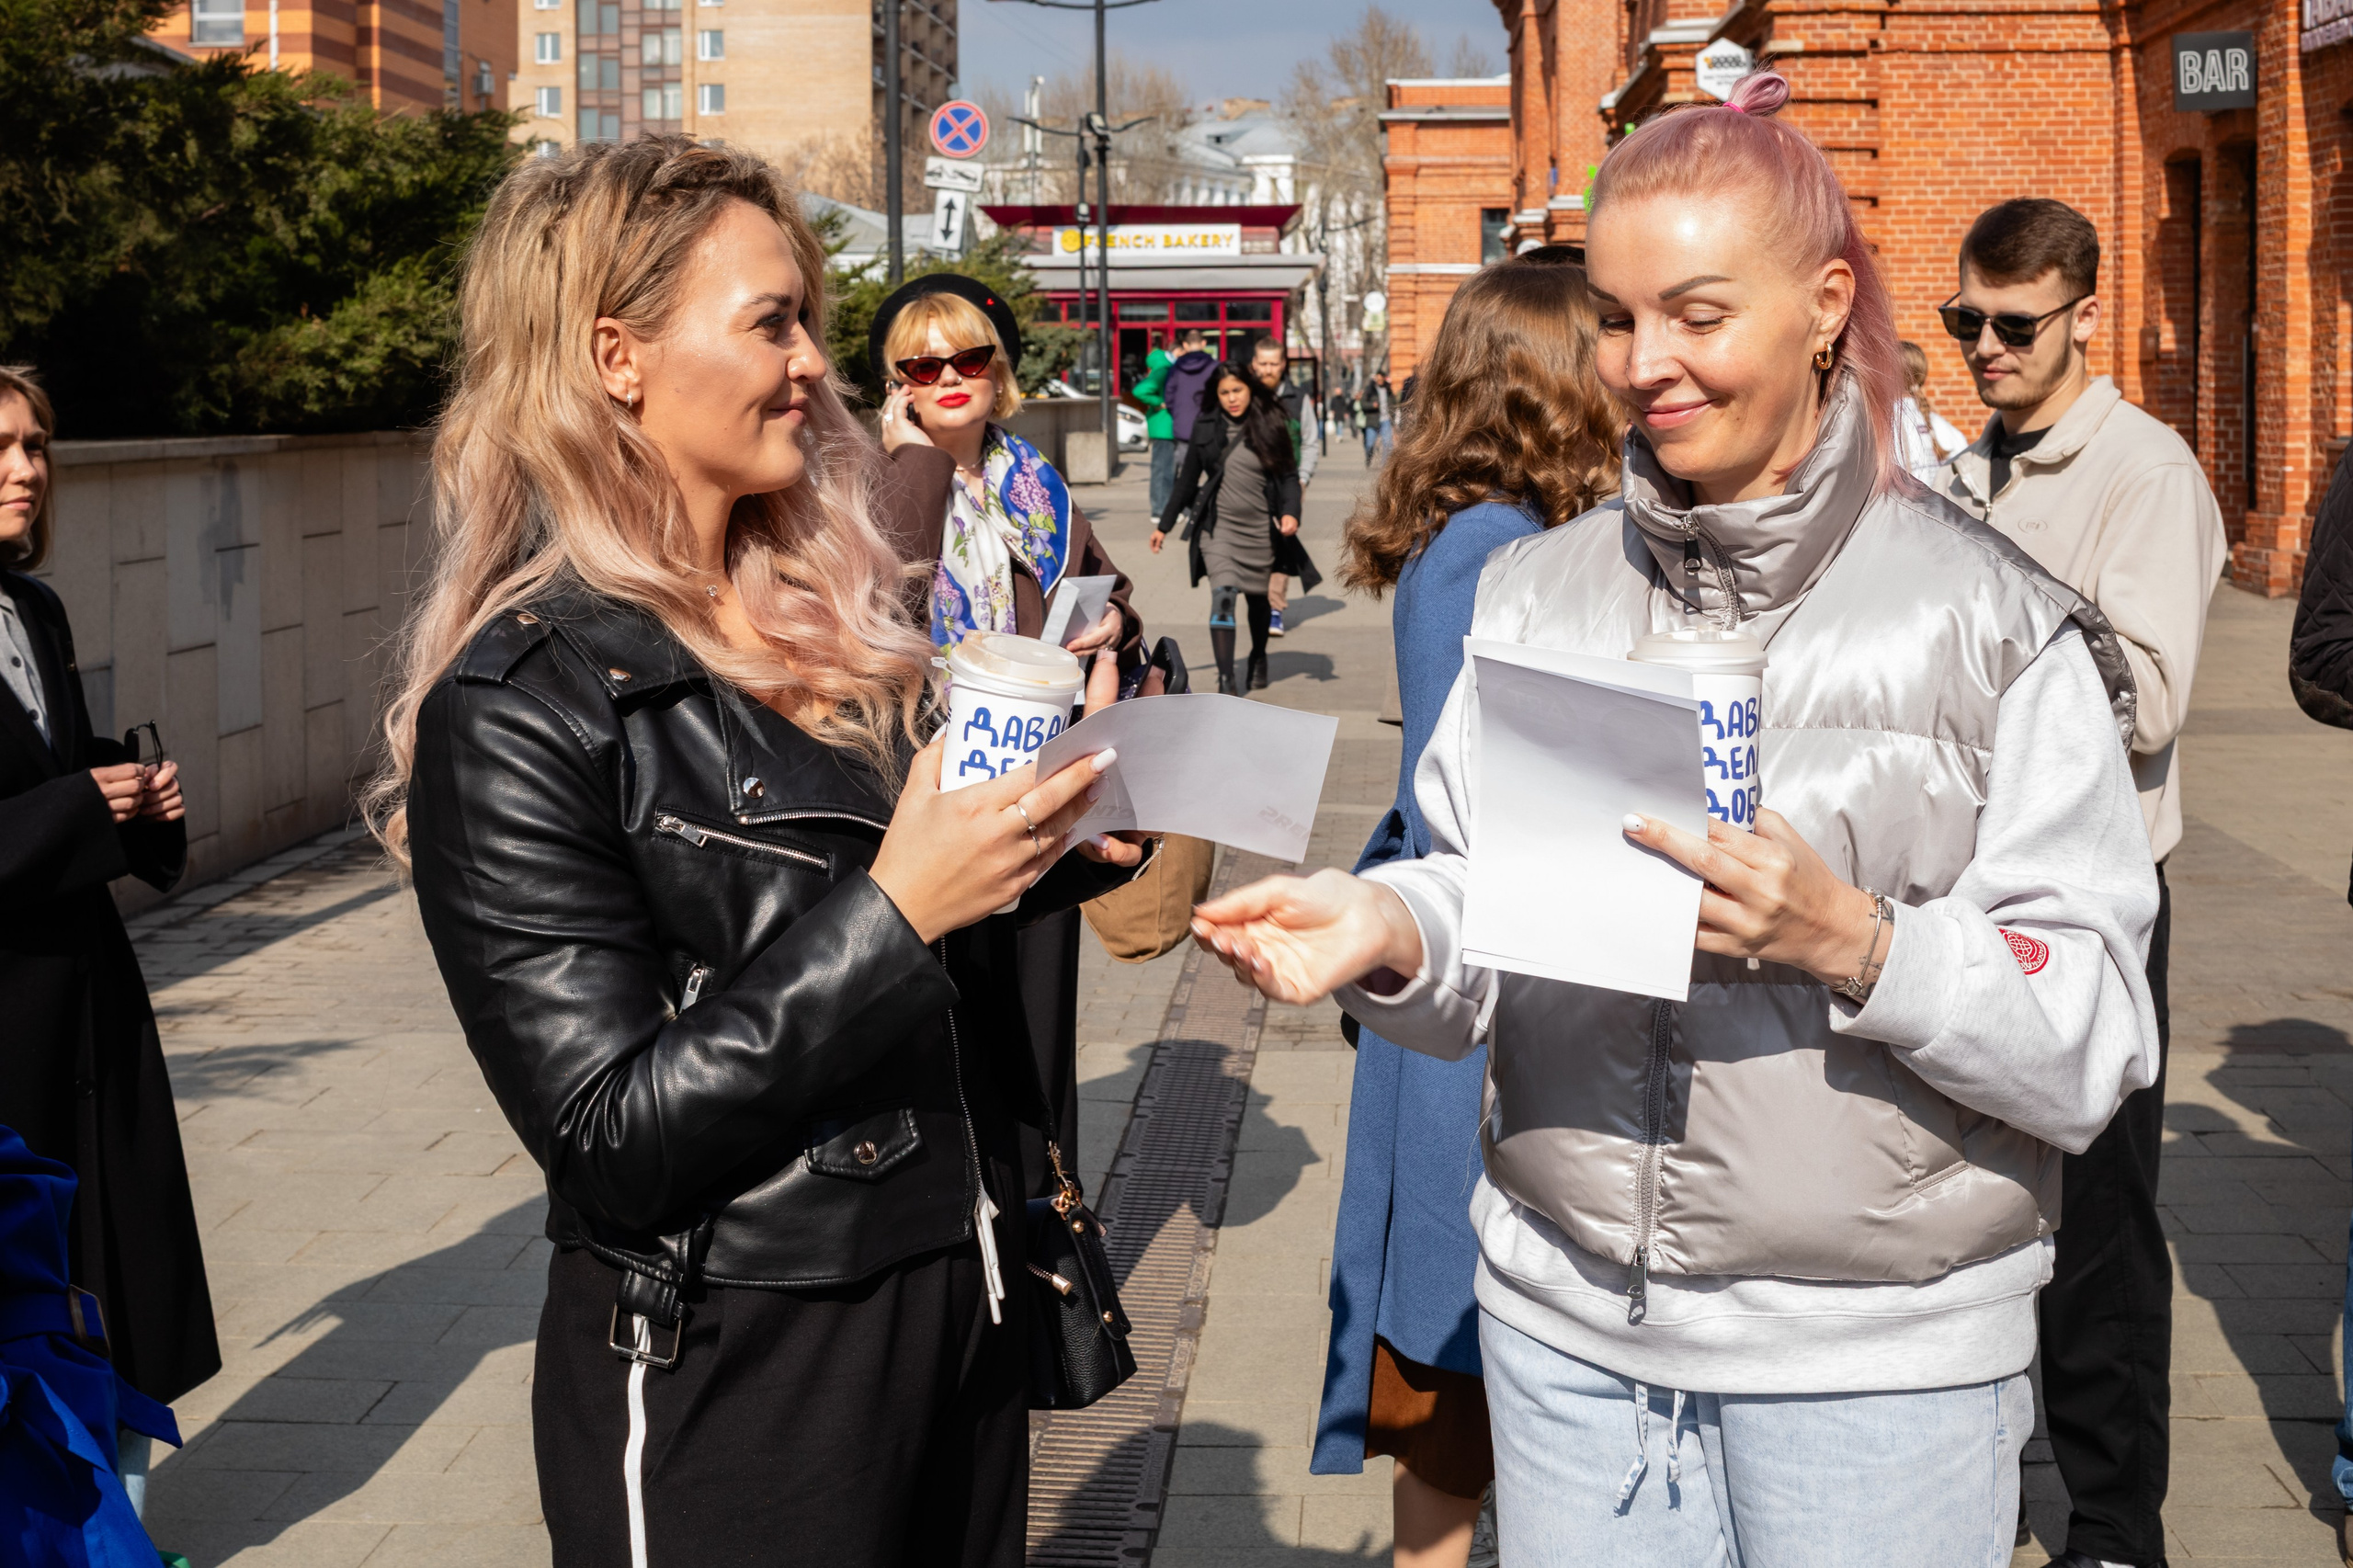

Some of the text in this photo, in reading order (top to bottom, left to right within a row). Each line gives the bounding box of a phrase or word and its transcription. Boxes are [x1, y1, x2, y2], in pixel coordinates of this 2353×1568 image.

[2179, 49, 2249, 94] BAR
[1163, 233, 1233, 248] BAKERY
[1700, 694, 1762, 740] ДАВ
[1703, 744, 1759, 779] ДЕЛ
